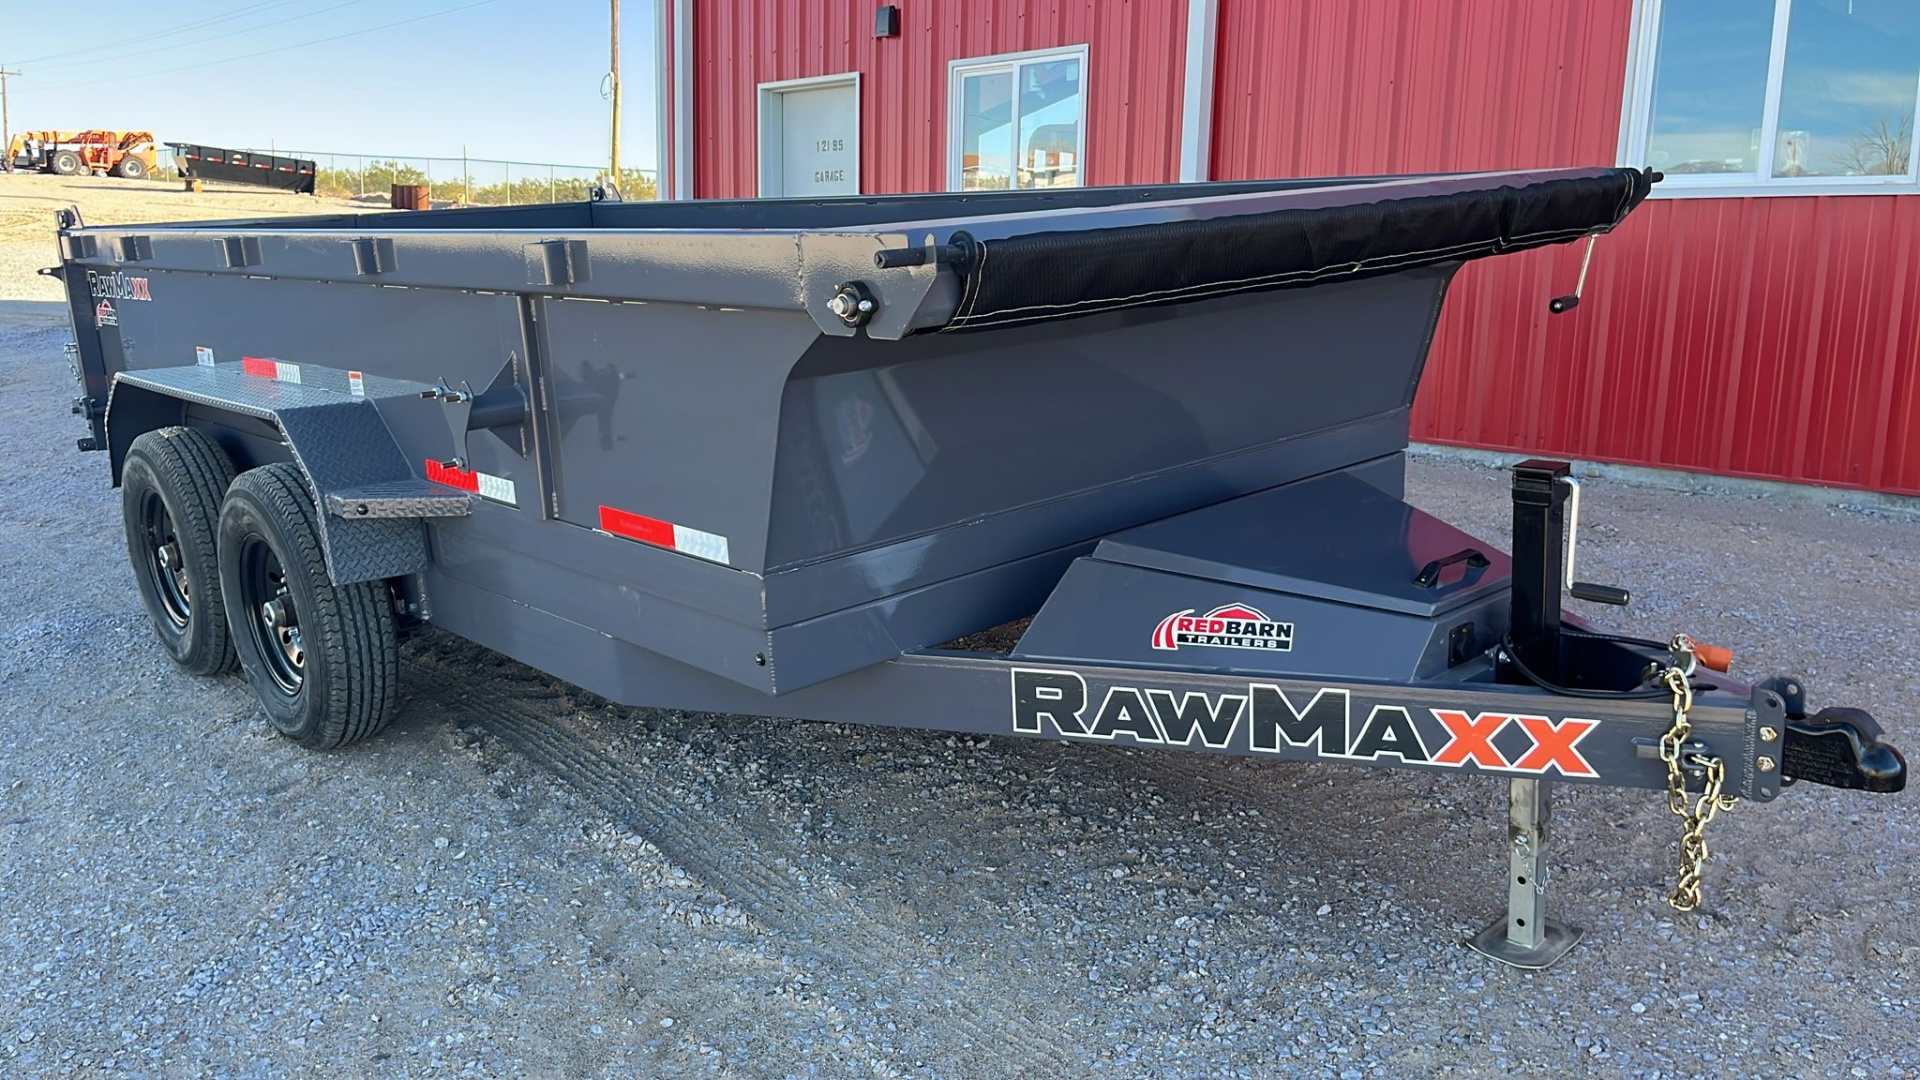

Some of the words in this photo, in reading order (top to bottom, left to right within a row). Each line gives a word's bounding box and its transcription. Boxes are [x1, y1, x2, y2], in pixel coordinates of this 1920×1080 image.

[815, 170, 844, 183] GARAGE
[1186, 635, 1278, 648] TRAILERS
[1011, 668, 1602, 778] RAWMAXX
